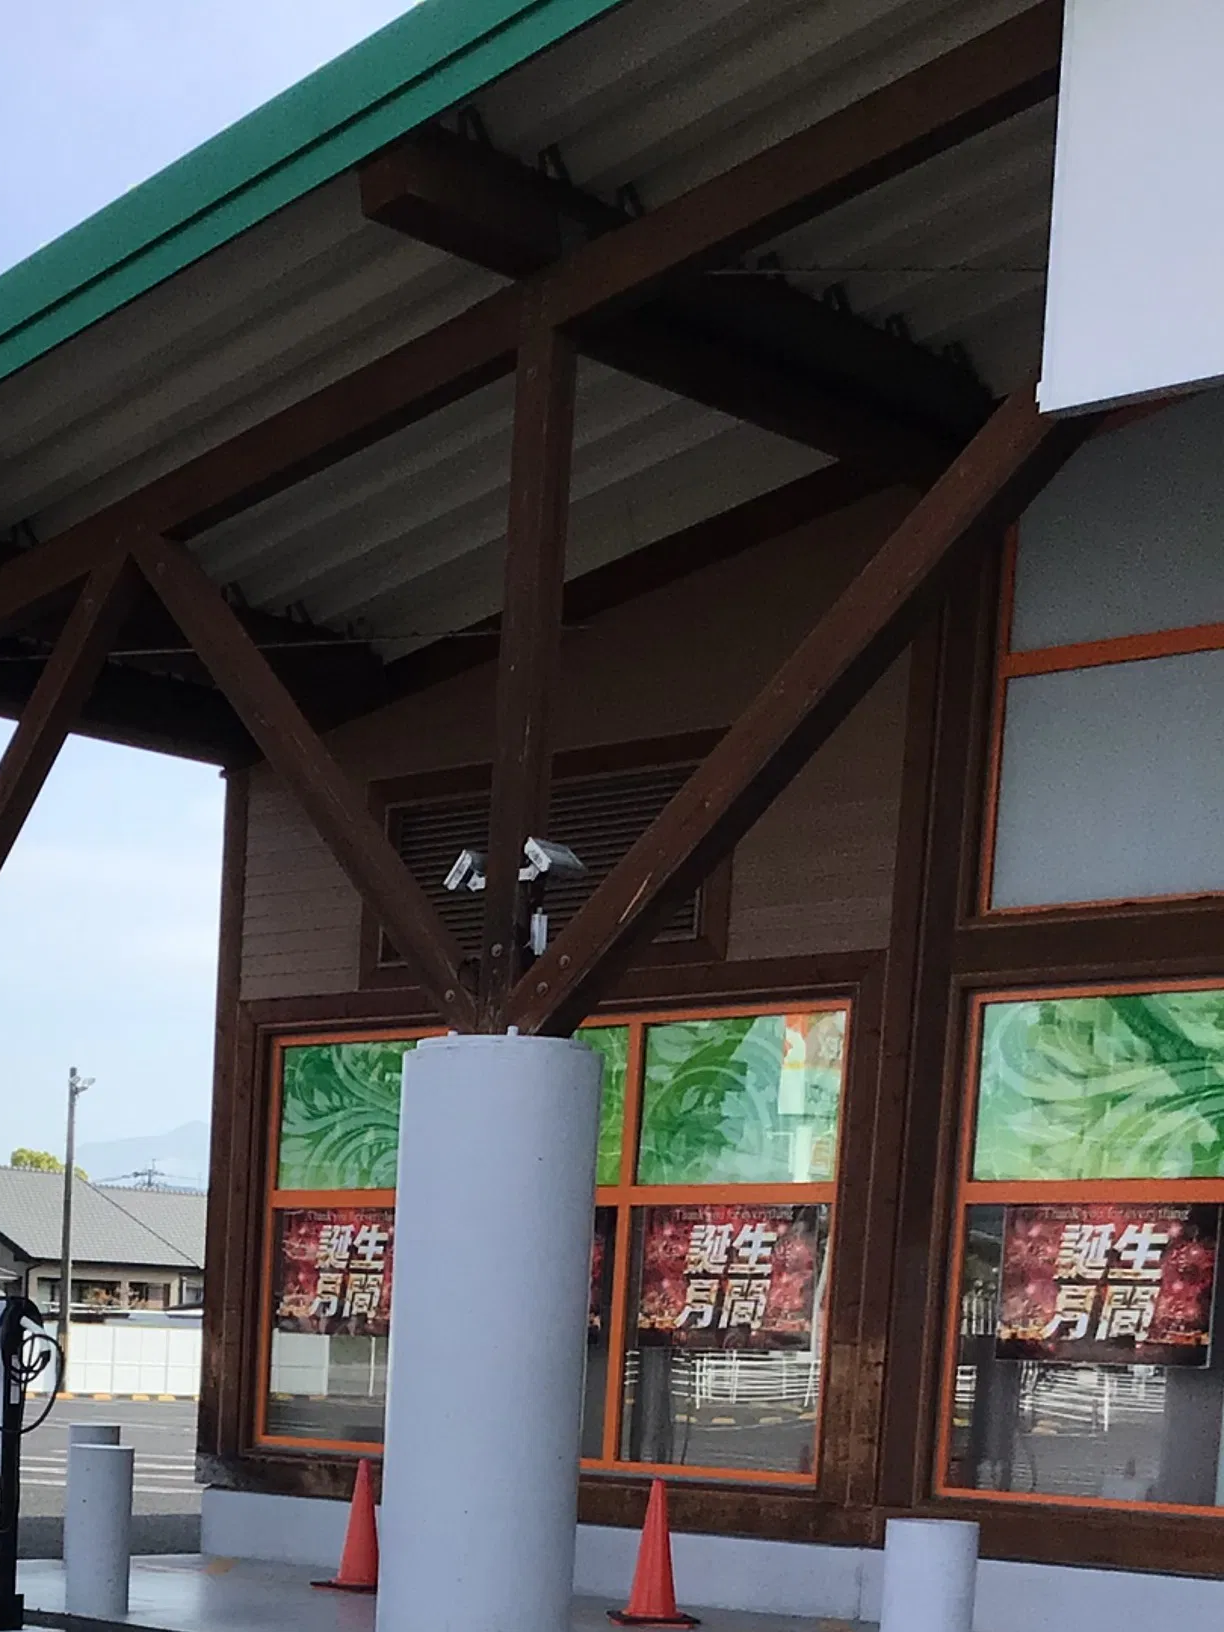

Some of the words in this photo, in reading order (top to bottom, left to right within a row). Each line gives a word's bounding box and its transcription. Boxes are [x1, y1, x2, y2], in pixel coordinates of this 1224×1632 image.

[315, 1224, 389, 1270] 誕生
[683, 1223, 777, 1275] 誕生
[1053, 1223, 1169, 1281] 誕生
[309, 1273, 384, 1319] 月間
[674, 1279, 771, 1329] 月間
[1040, 1285, 1160, 1341] 月間
